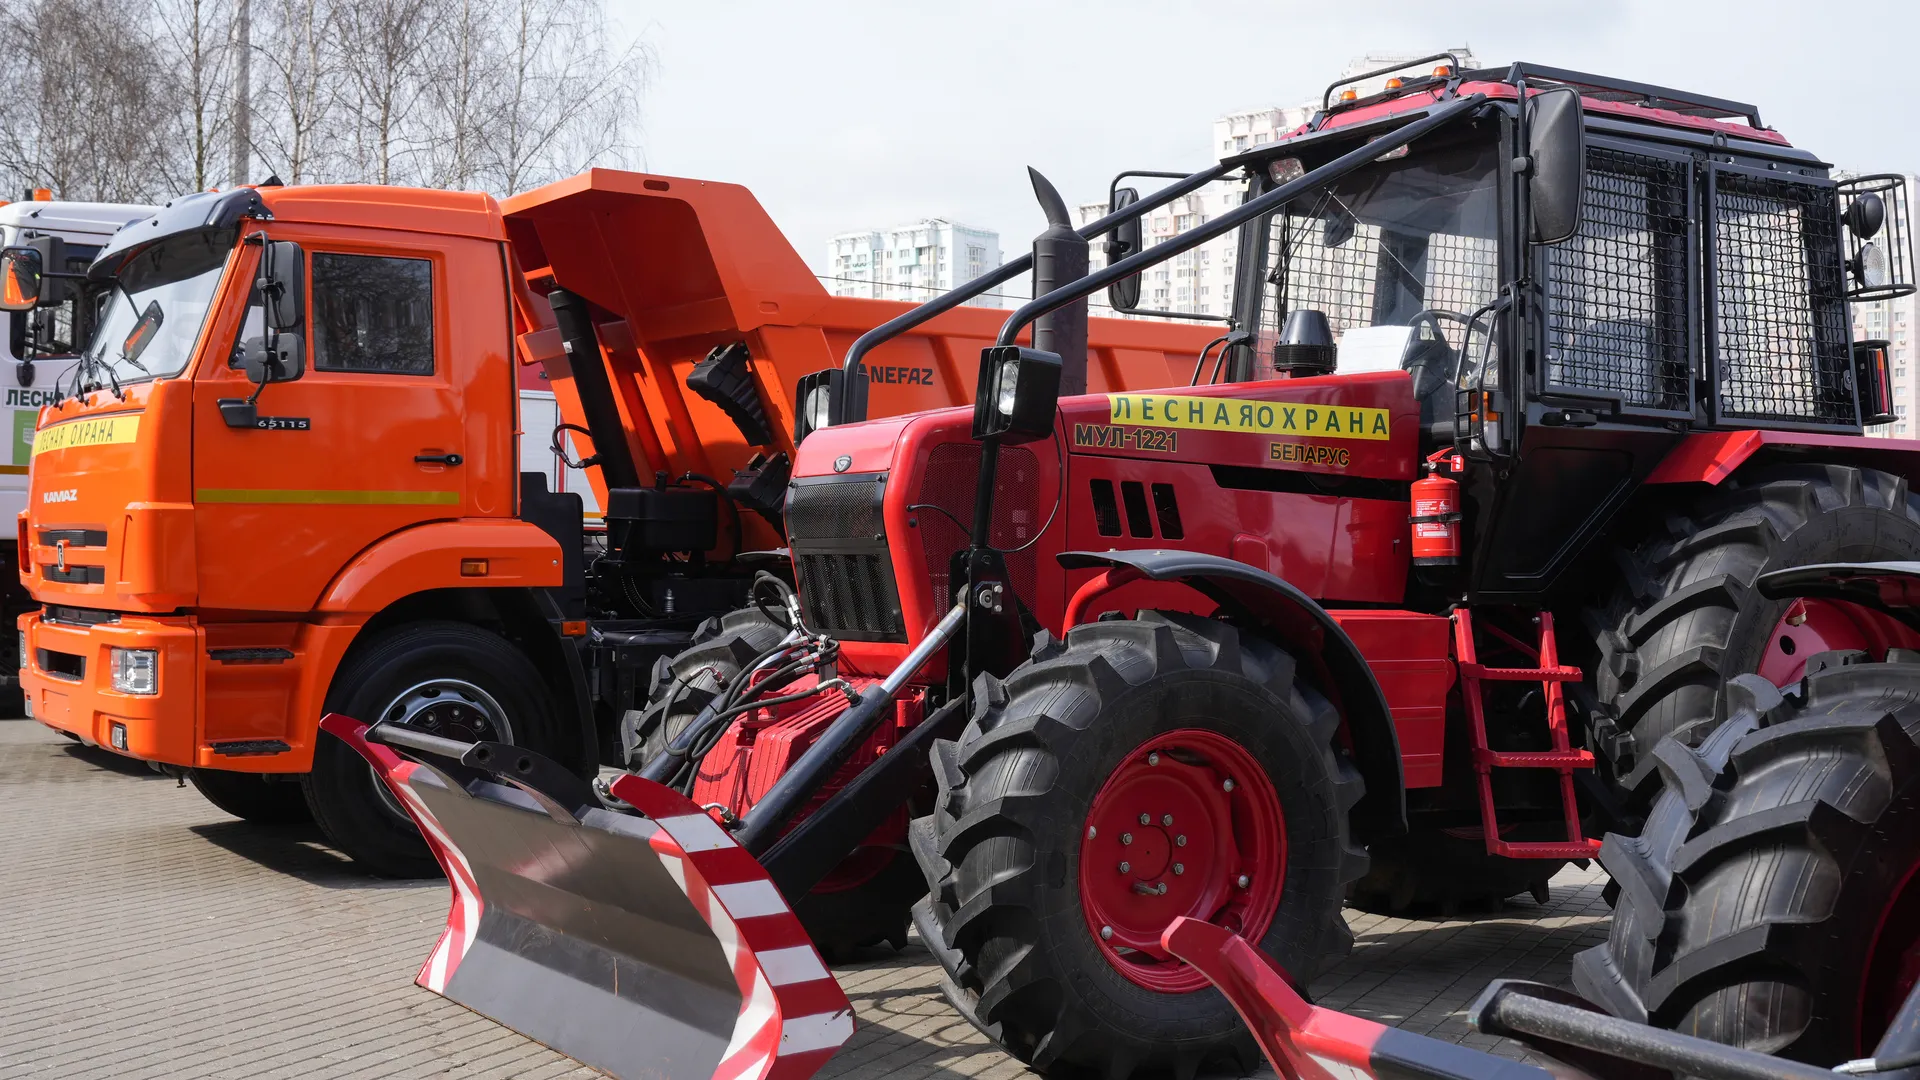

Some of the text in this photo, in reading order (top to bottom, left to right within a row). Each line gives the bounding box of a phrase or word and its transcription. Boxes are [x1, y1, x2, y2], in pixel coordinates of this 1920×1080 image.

[871, 366, 933, 385] NEFAZ
[71, 420, 114, 445] ОХРАНА
[258, 420, 307, 428] 65115
[1075, 423, 1178, 453] МУЛ-1221
[1270, 441, 1350, 468] БЕЛАРУС
[43, 489, 78, 504] KAMAZ
